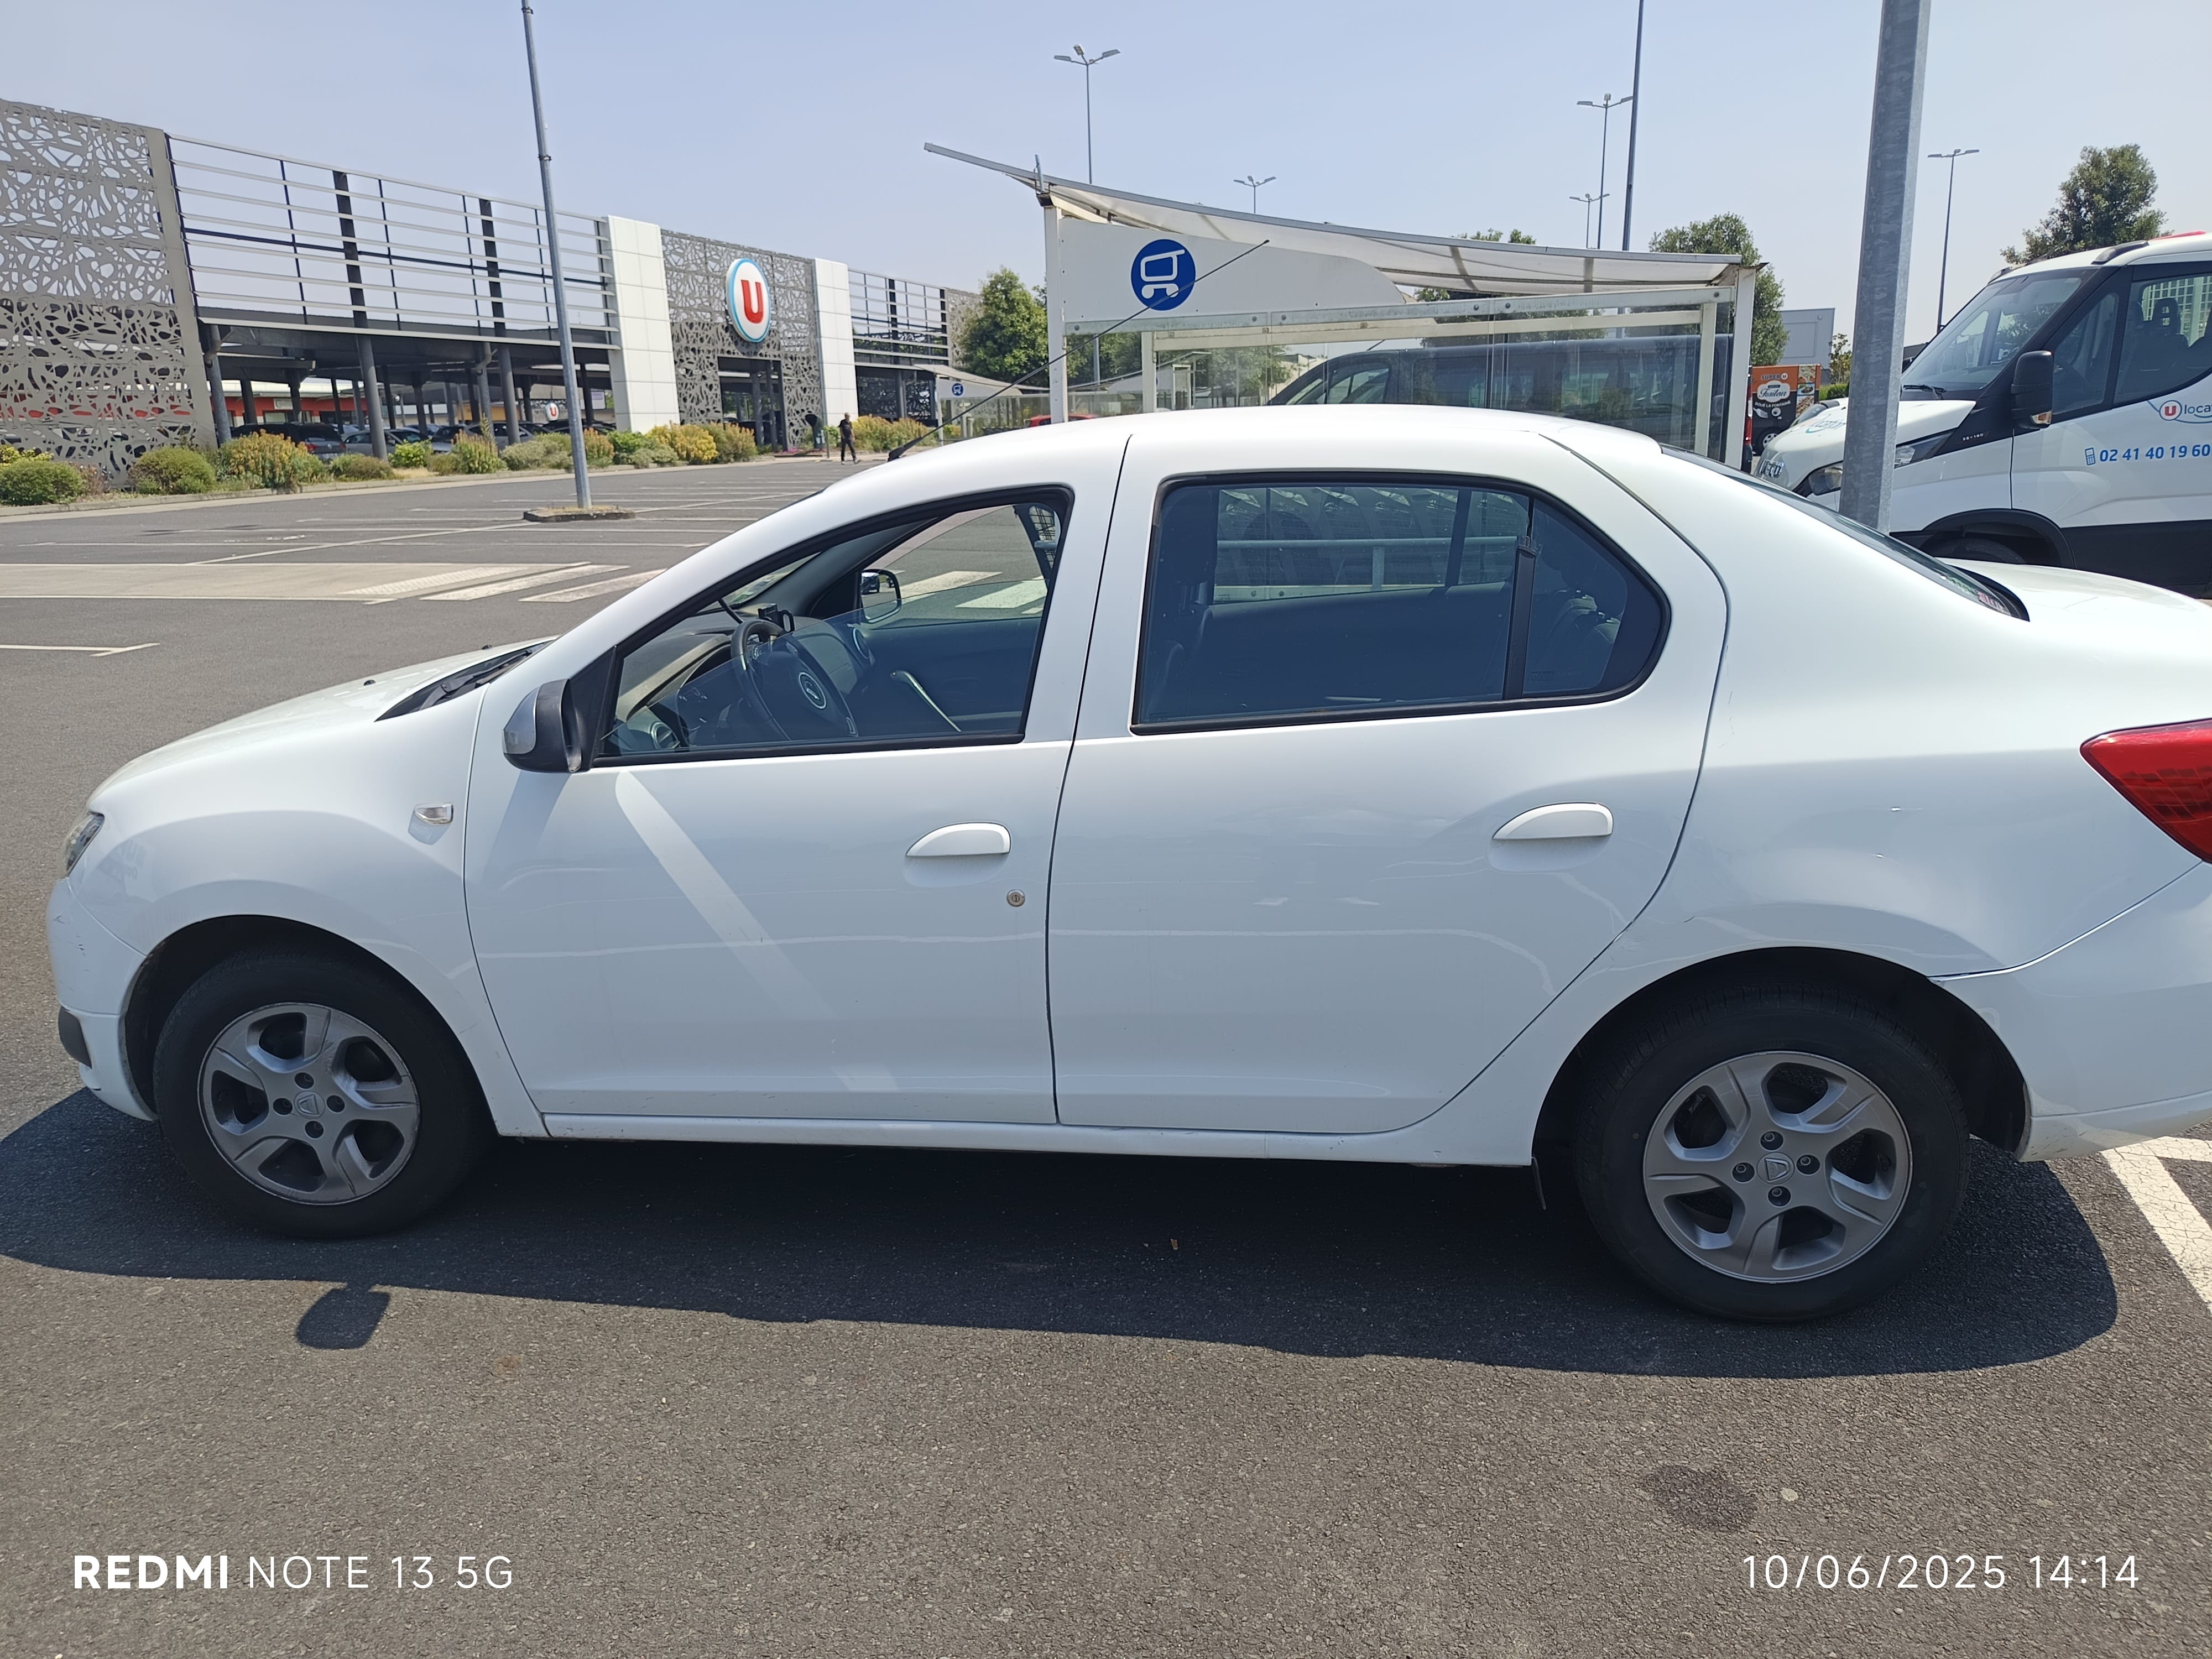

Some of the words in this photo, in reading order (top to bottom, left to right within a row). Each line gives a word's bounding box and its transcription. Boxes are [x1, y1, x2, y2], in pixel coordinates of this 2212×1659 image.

[740, 279, 764, 324] U
[2164, 405, 2177, 416] U
[2184, 404, 2212, 414] loca
[2100, 449, 2118, 462] 02
[2122, 448, 2140, 461] 41
[2145, 446, 2164, 459] 40
[2170, 445, 2188, 458] 19
[2192, 444, 2211, 457] 60
